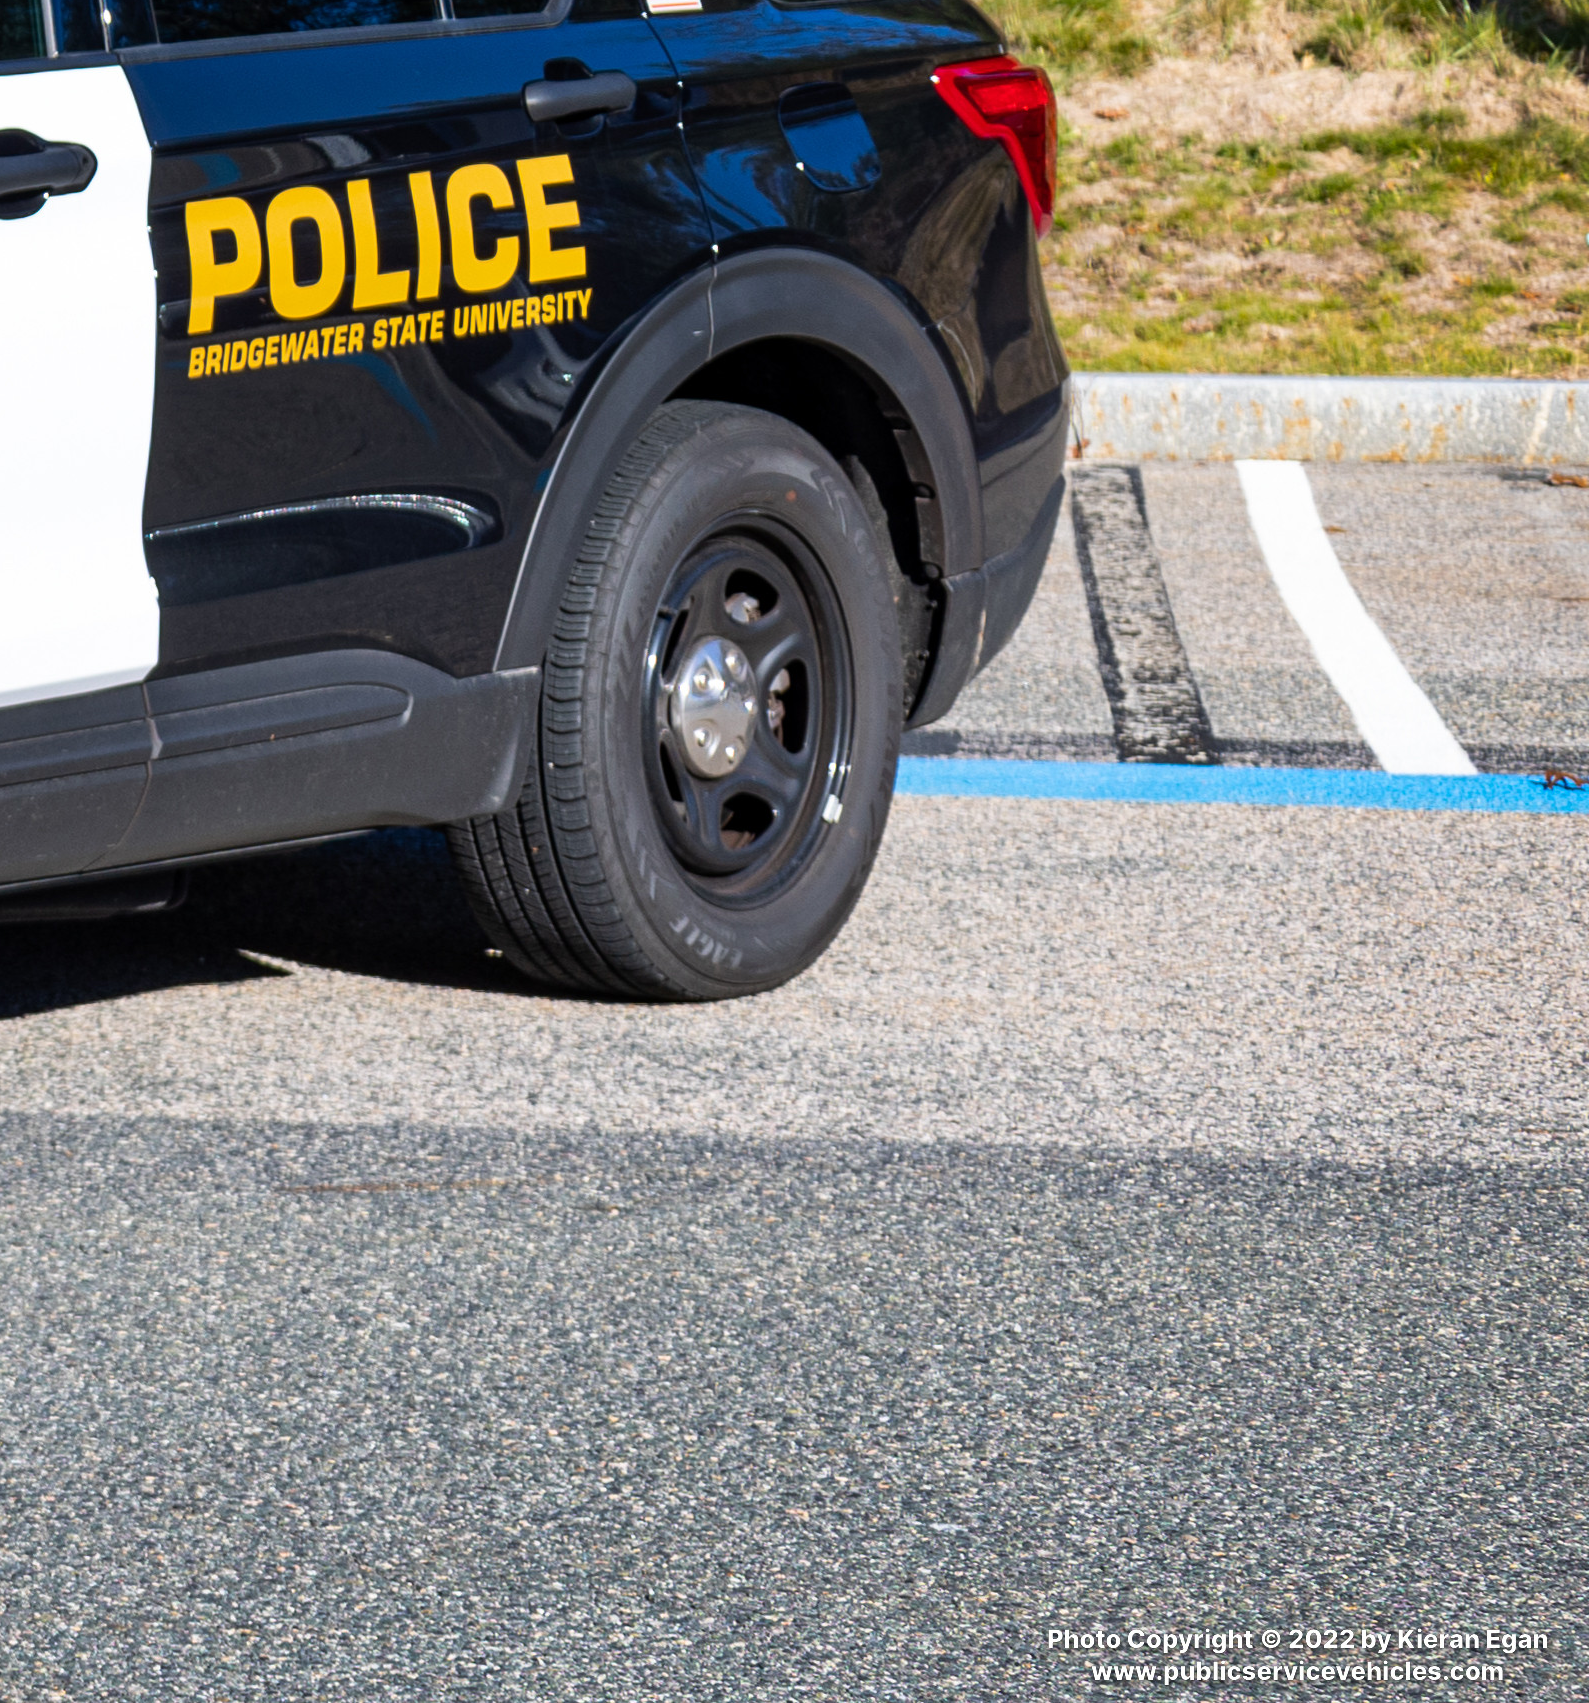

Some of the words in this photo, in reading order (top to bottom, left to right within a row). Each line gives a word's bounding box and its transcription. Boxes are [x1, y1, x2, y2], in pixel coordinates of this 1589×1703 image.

[185, 154, 587, 335] POLICE
[188, 323, 364, 379] BRIDGEWATER
[372, 310, 446, 349] STATE
[453, 288, 593, 337] UNIVERSITY
